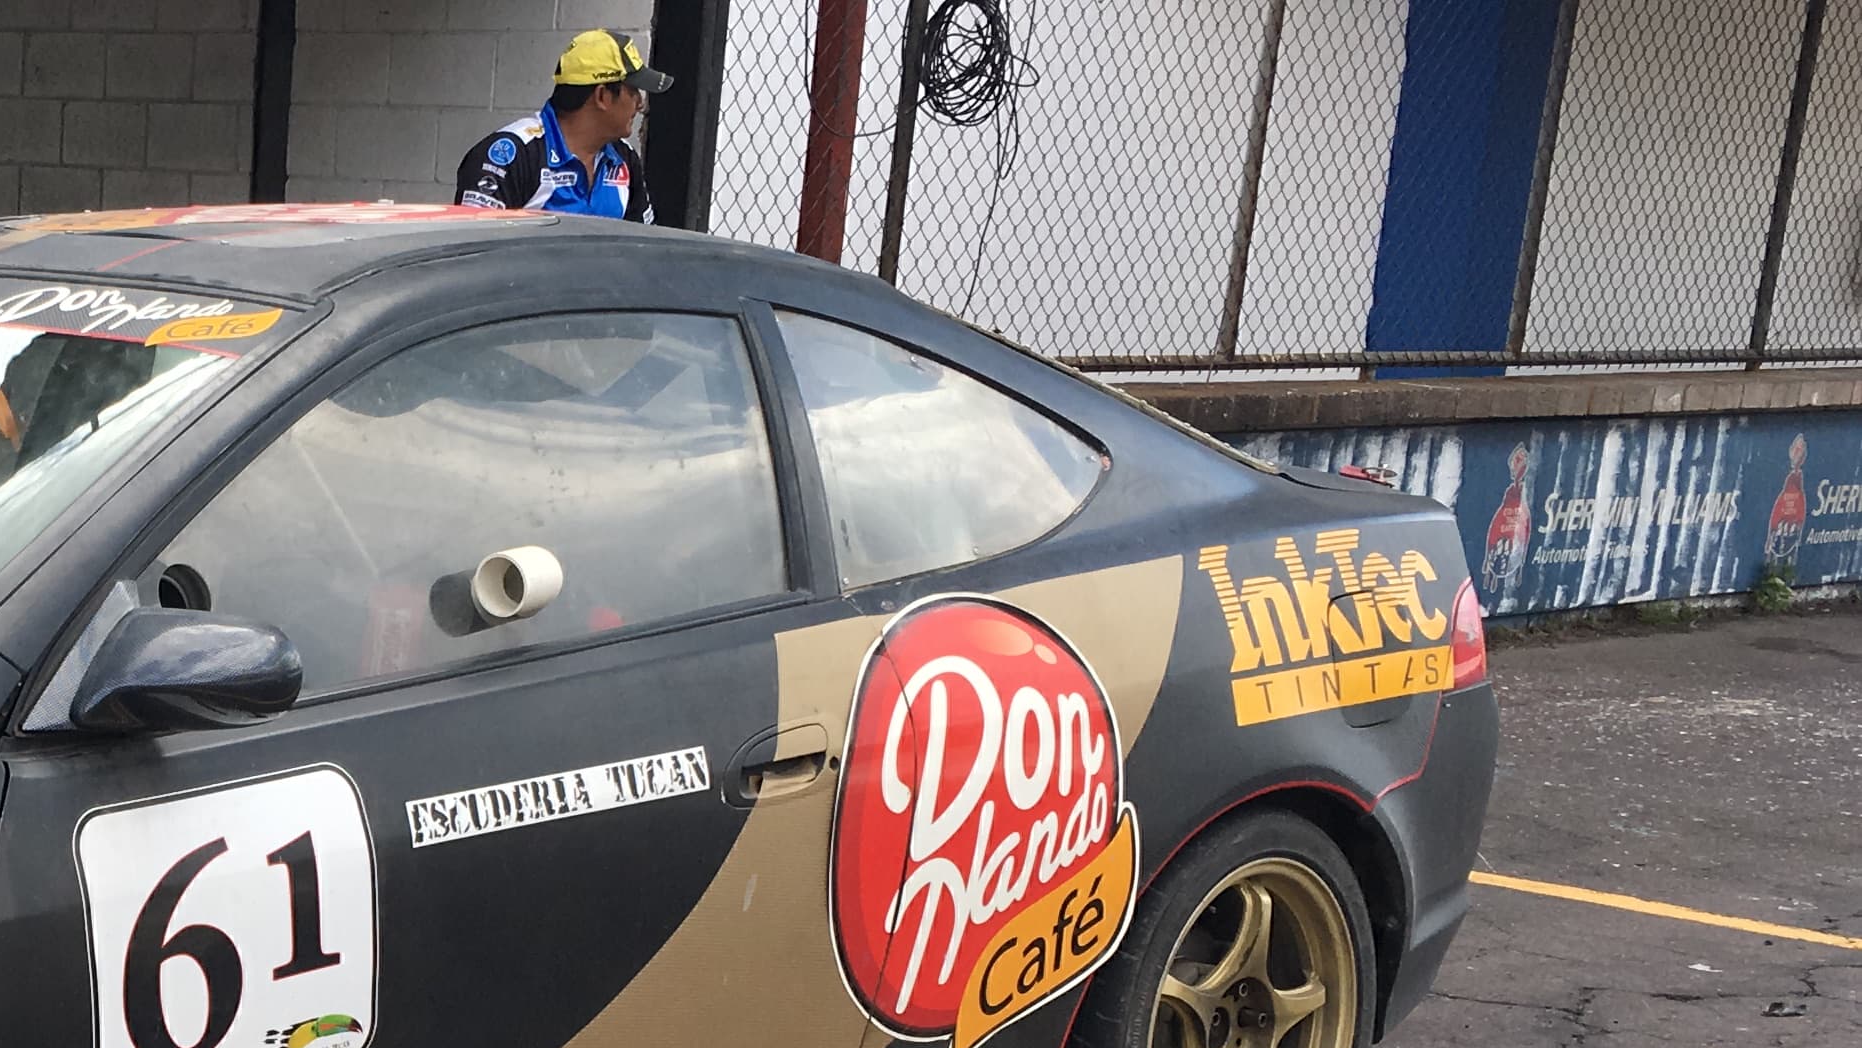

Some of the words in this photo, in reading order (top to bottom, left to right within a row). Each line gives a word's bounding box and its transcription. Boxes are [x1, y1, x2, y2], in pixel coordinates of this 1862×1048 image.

[166, 318, 256, 338] Café
[1538, 493, 1640, 534] SHERIN
[1647, 489, 1741, 526] WLIAMS
[1811, 479, 1862, 516] SHER
[1532, 545, 1601, 564] Automote
[1256, 653, 1438, 713] TINTAS
[882, 655, 1105, 862] Don
[413, 773, 593, 843] ESCUDERIA
[605, 750, 707, 803] TUCAN
[979, 879, 1105, 1015] Café
